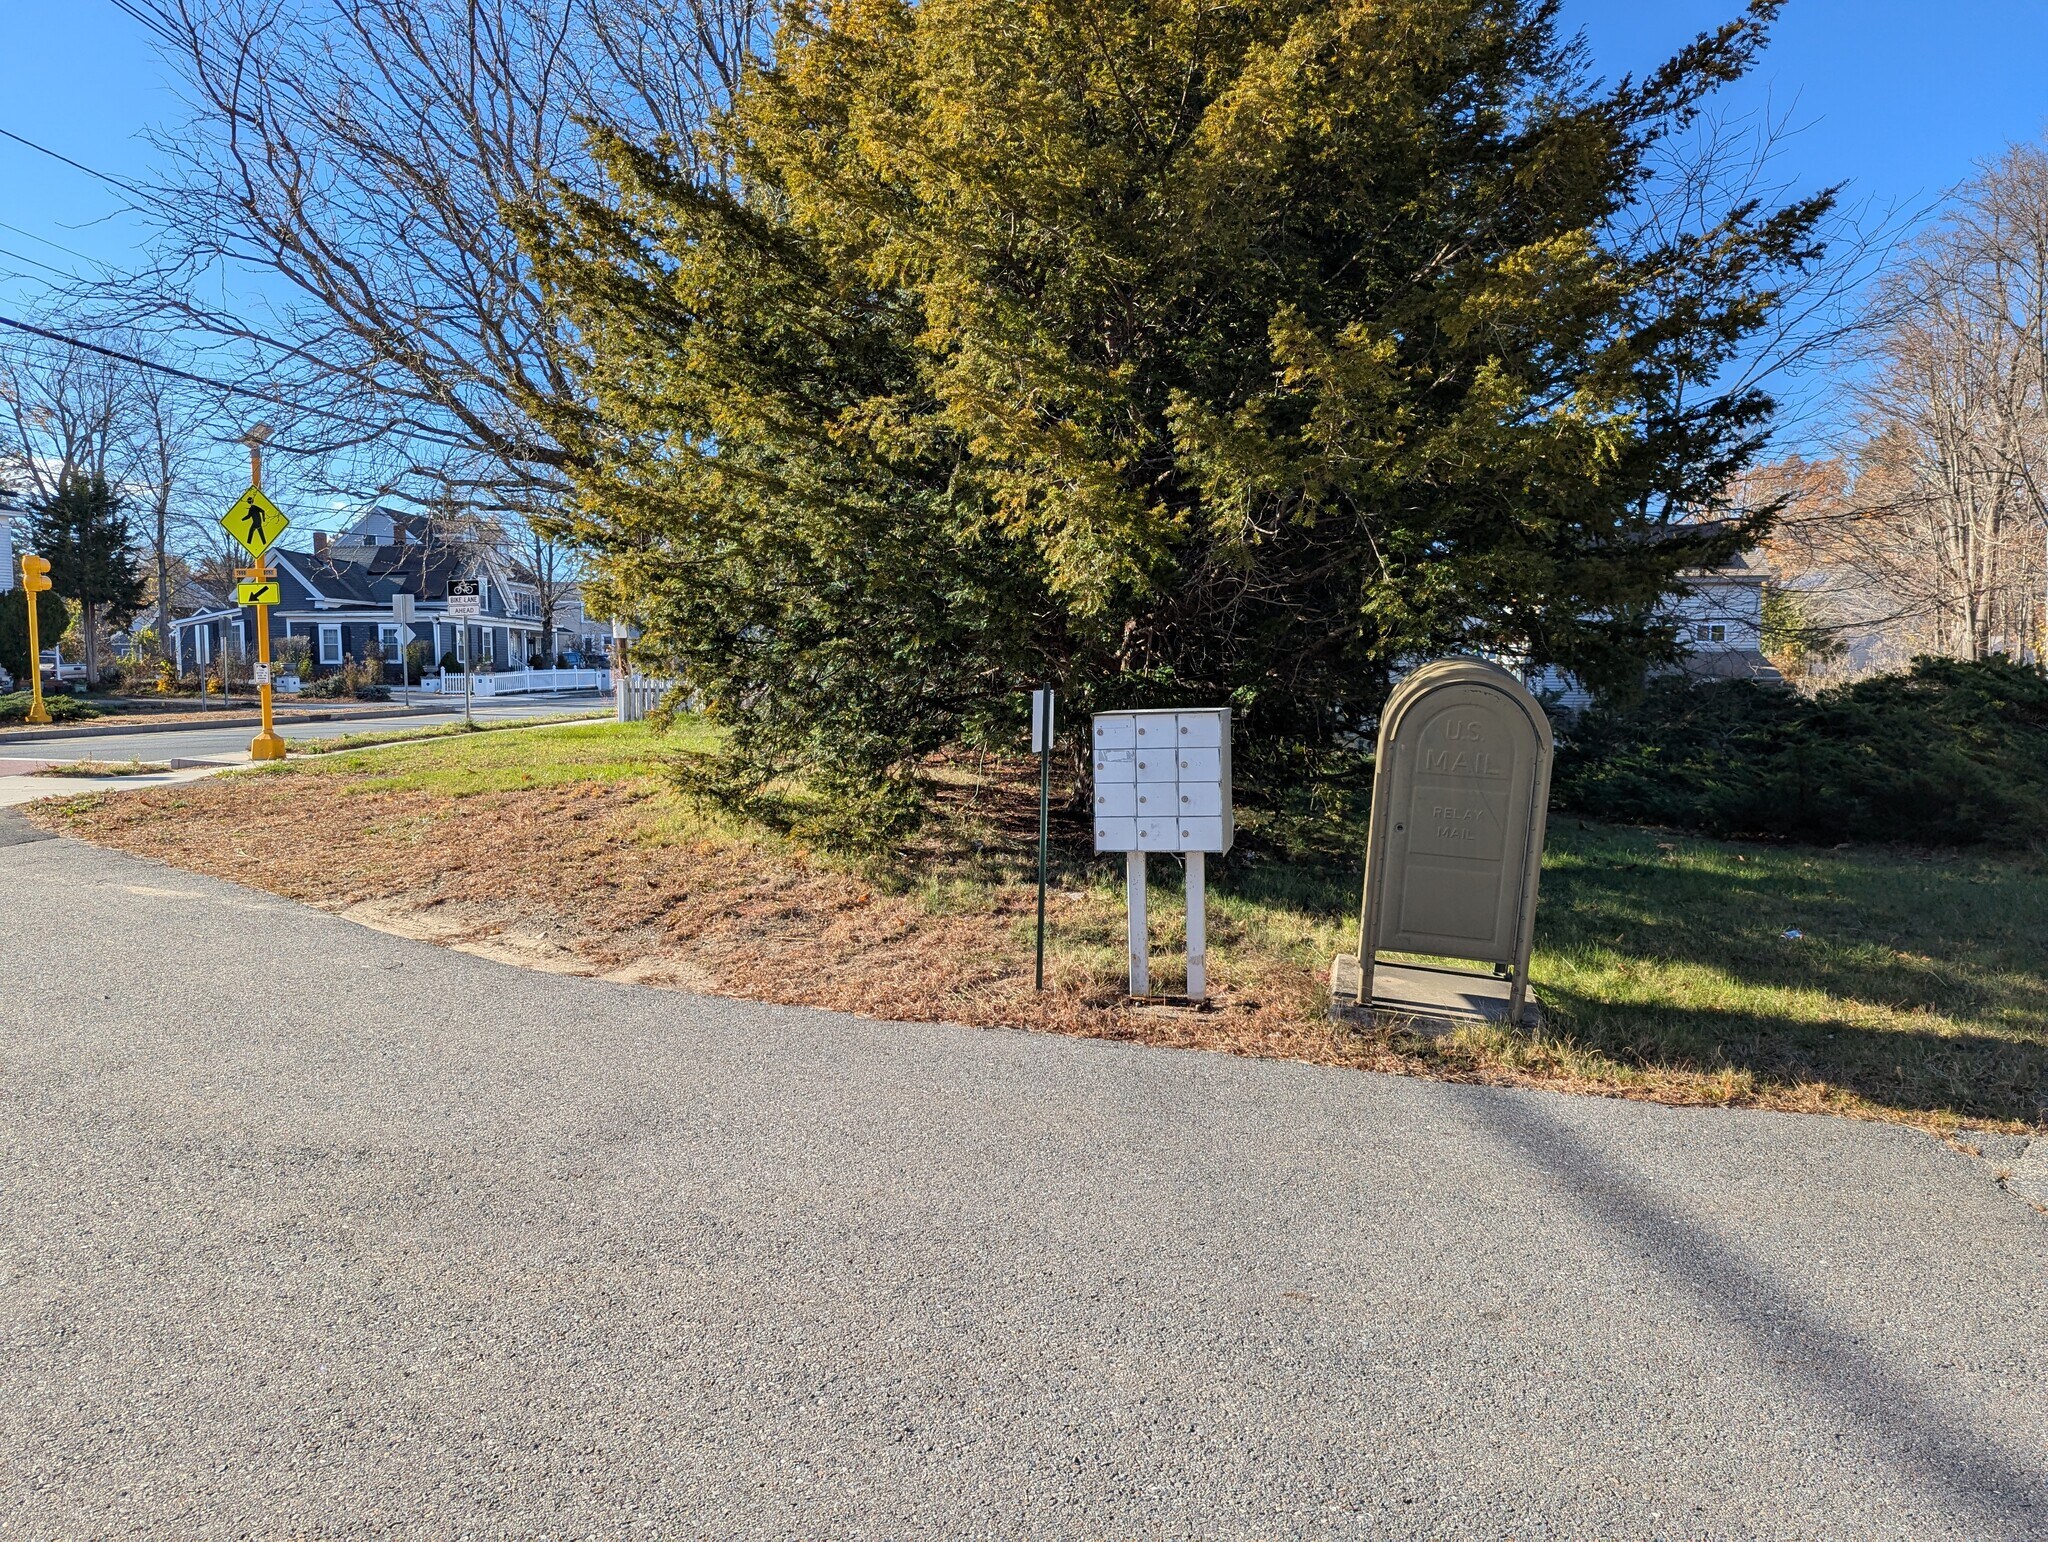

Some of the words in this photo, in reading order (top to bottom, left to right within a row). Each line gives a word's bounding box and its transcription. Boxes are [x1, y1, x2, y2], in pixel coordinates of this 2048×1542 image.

[1445, 719, 1486, 742] U.S.
[1425, 748, 1500, 776] MAIL
[1432, 806, 1483, 821] RELAY
[1436, 826, 1475, 840] MAIL
